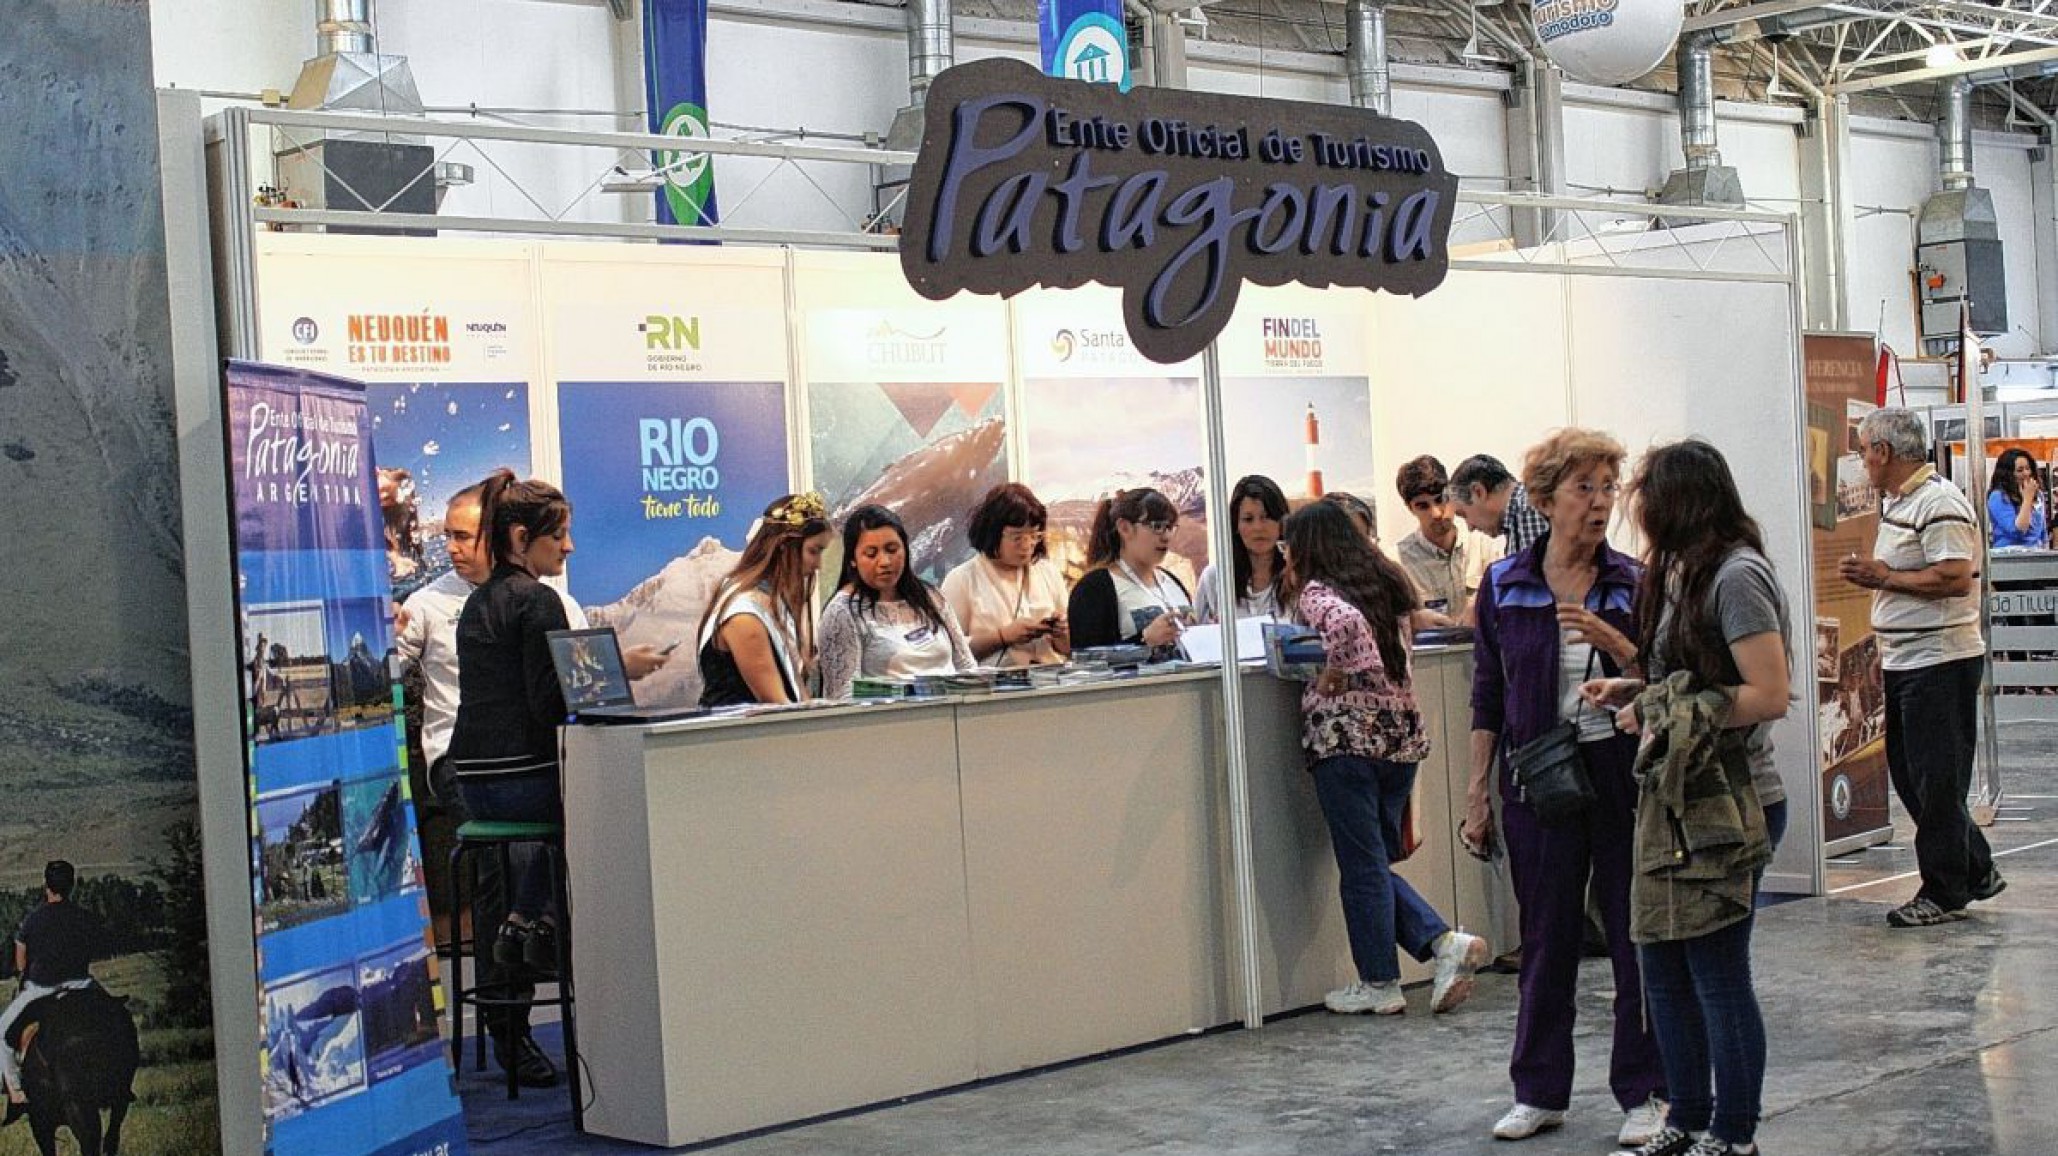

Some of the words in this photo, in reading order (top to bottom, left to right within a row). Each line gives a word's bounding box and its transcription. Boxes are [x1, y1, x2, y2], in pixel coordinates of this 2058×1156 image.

[1536, 0, 1617, 25] urismo
[1538, 10, 1613, 41] omodoro
[1046, 107, 1131, 150] Ente
[1140, 117, 1247, 160] Oficial
[1262, 125, 1304, 163] de
[1312, 130, 1432, 174] Turismo
[927, 92, 1442, 330] Patagonia
[347, 306, 449, 343] NEUQUÉN
[646, 315, 700, 350] RN
[1080, 328, 1124, 348] Santa
[348, 345, 366, 363] ES
[369, 345, 387, 363] TU
[392, 345, 452, 363] DESTINO
[1264, 339, 1322, 358] MUNDO
[246, 402, 360, 508] Patagonia
[639, 417, 719, 466] RIO
[642, 466, 720, 491] NEGRO
[256, 481, 361, 506] ARGENTINA
[640, 493, 682, 520] tiene
[682, 493, 720, 519] todo
[1989, 594, 2010, 613] da
